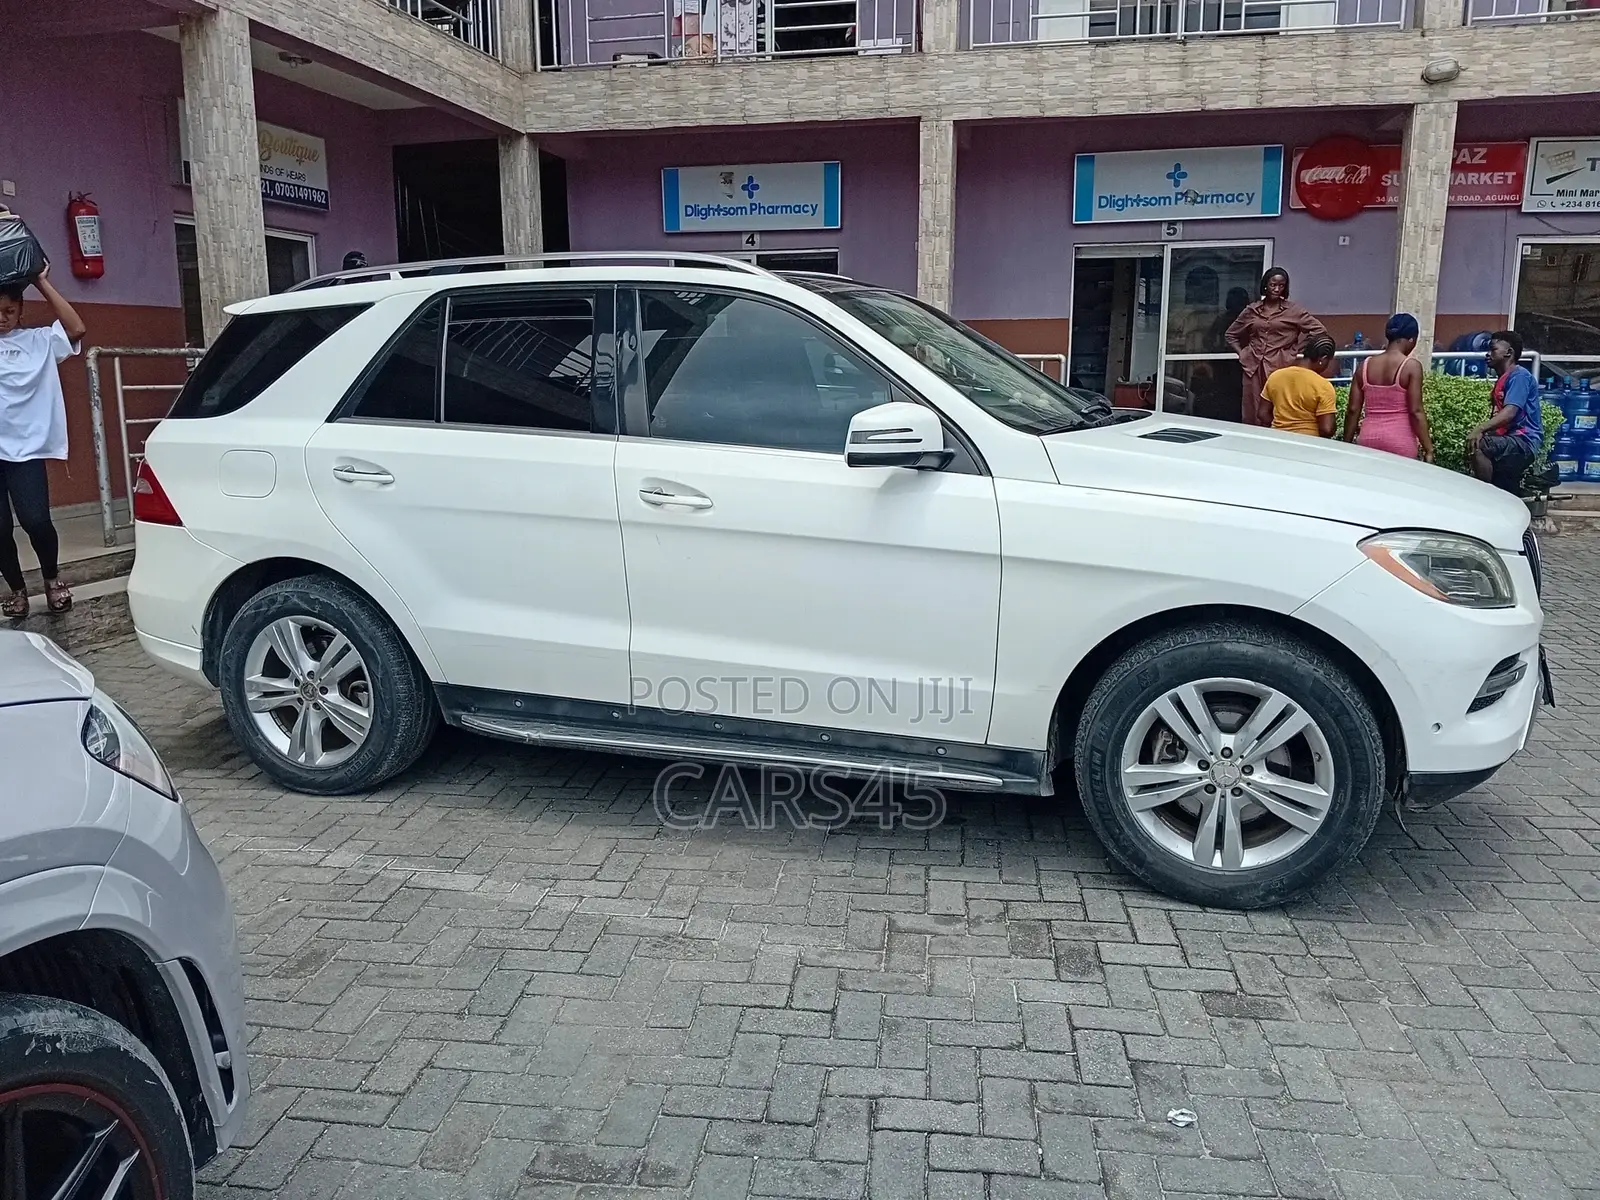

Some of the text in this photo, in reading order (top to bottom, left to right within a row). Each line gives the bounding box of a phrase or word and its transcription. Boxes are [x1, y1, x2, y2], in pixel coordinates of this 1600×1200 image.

[259, 130, 320, 166] Boutique
[1452, 147, 1488, 164] AZ
[275, 168, 284, 177] OF
[275, 182, 326, 204] 07031491962
[1457, 195, 1483, 203] ROAD,
[1485, 194, 1520, 202] AGUNGI
[1556, 189, 1600, 198] Mini Mar
[749, 202, 819, 217] Pharmacy
[1560, 200, 1582, 208] +234
[1166, 223, 1177, 236] 5
[745, 233, 756, 247] 4
